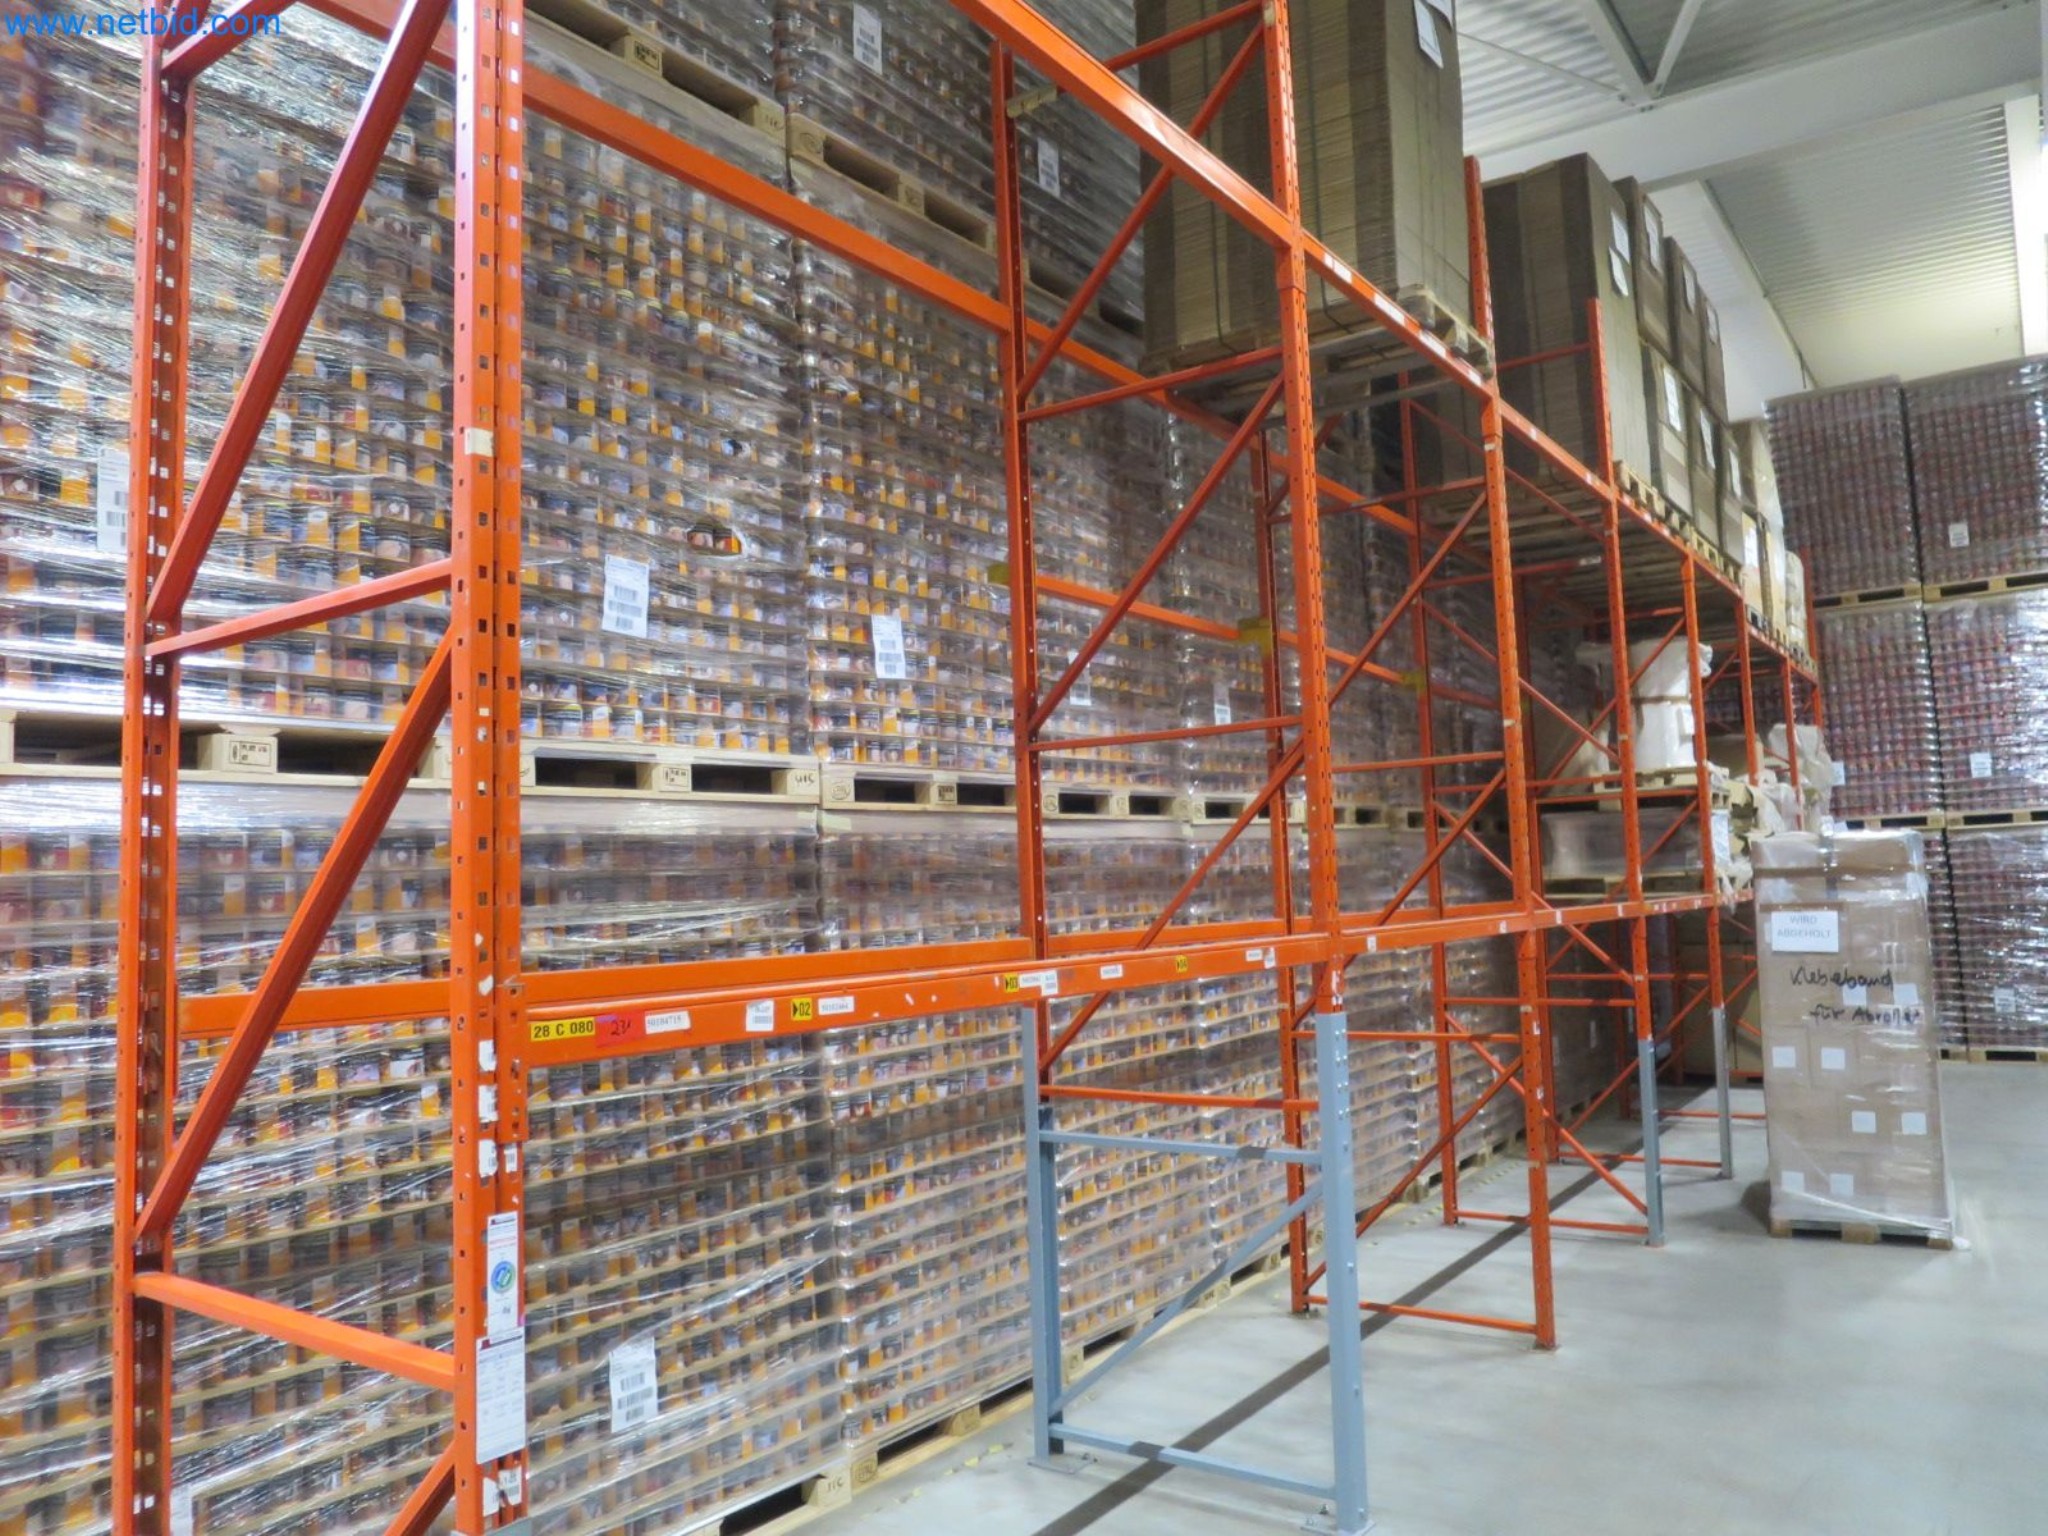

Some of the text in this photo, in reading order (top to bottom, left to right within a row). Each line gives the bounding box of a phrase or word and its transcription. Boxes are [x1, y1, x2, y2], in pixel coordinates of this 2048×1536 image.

[1789, 915, 1817, 924] WIRD
[1777, 928, 1831, 938] ABGEHOLT
[799, 1001, 811, 1017] 02
[533, 1020, 594, 1039] 28 C 080
